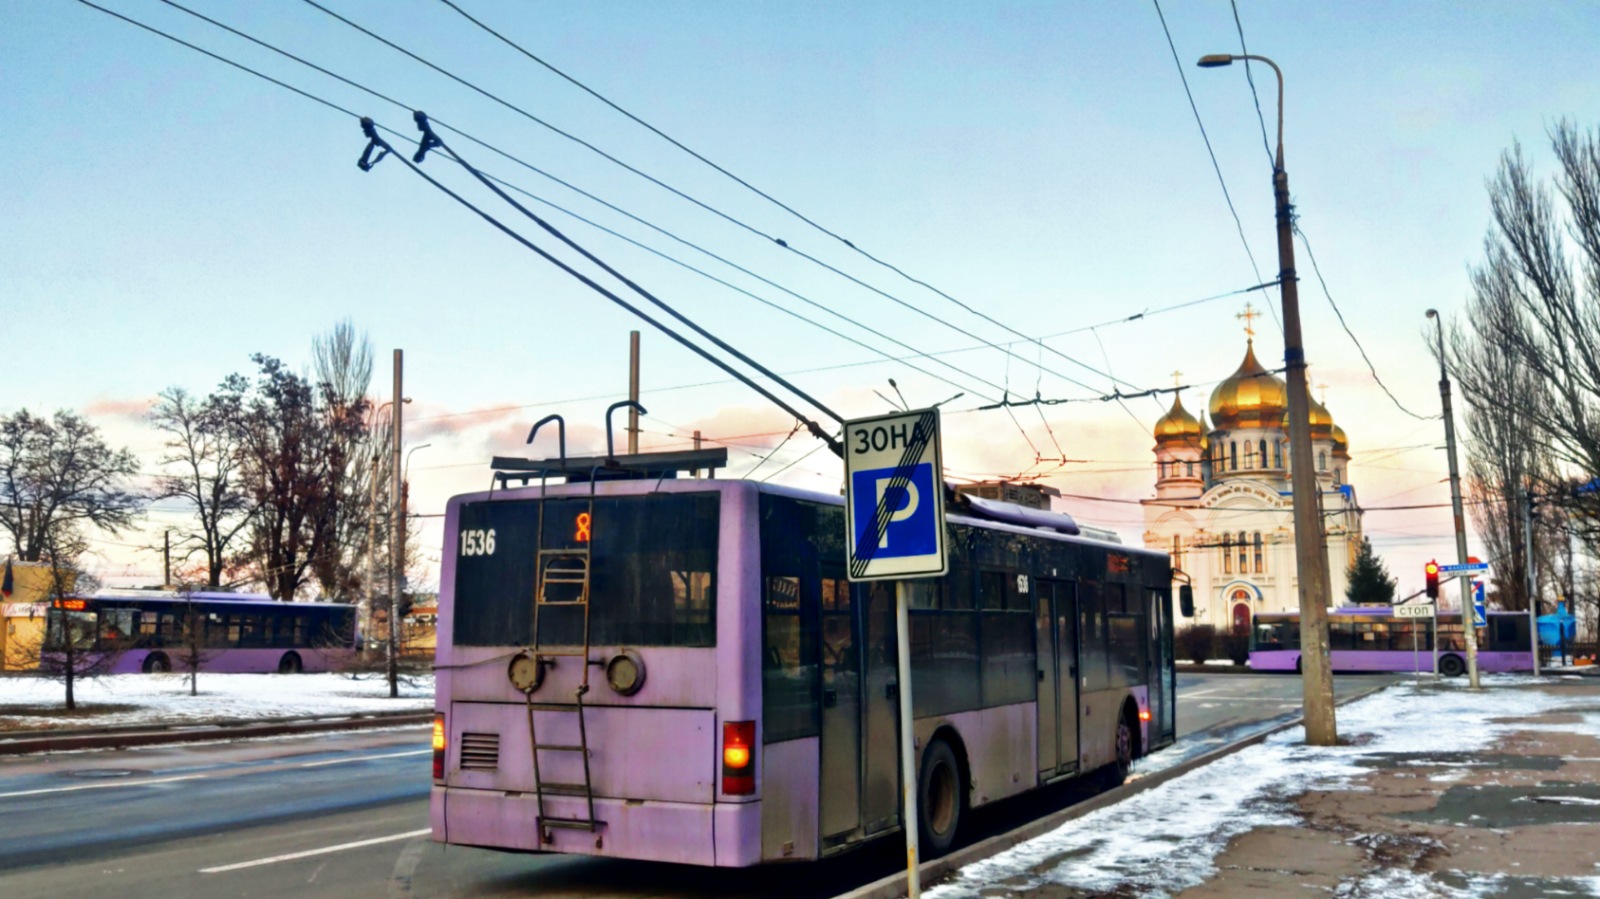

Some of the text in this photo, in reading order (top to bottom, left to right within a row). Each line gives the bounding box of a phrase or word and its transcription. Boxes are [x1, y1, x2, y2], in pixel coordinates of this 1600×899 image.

[854, 421, 927, 454] ЗОНА
[575, 512, 591, 542] 8
[460, 528, 496, 556] 1536
[1399, 606, 1429, 616] СТОП
